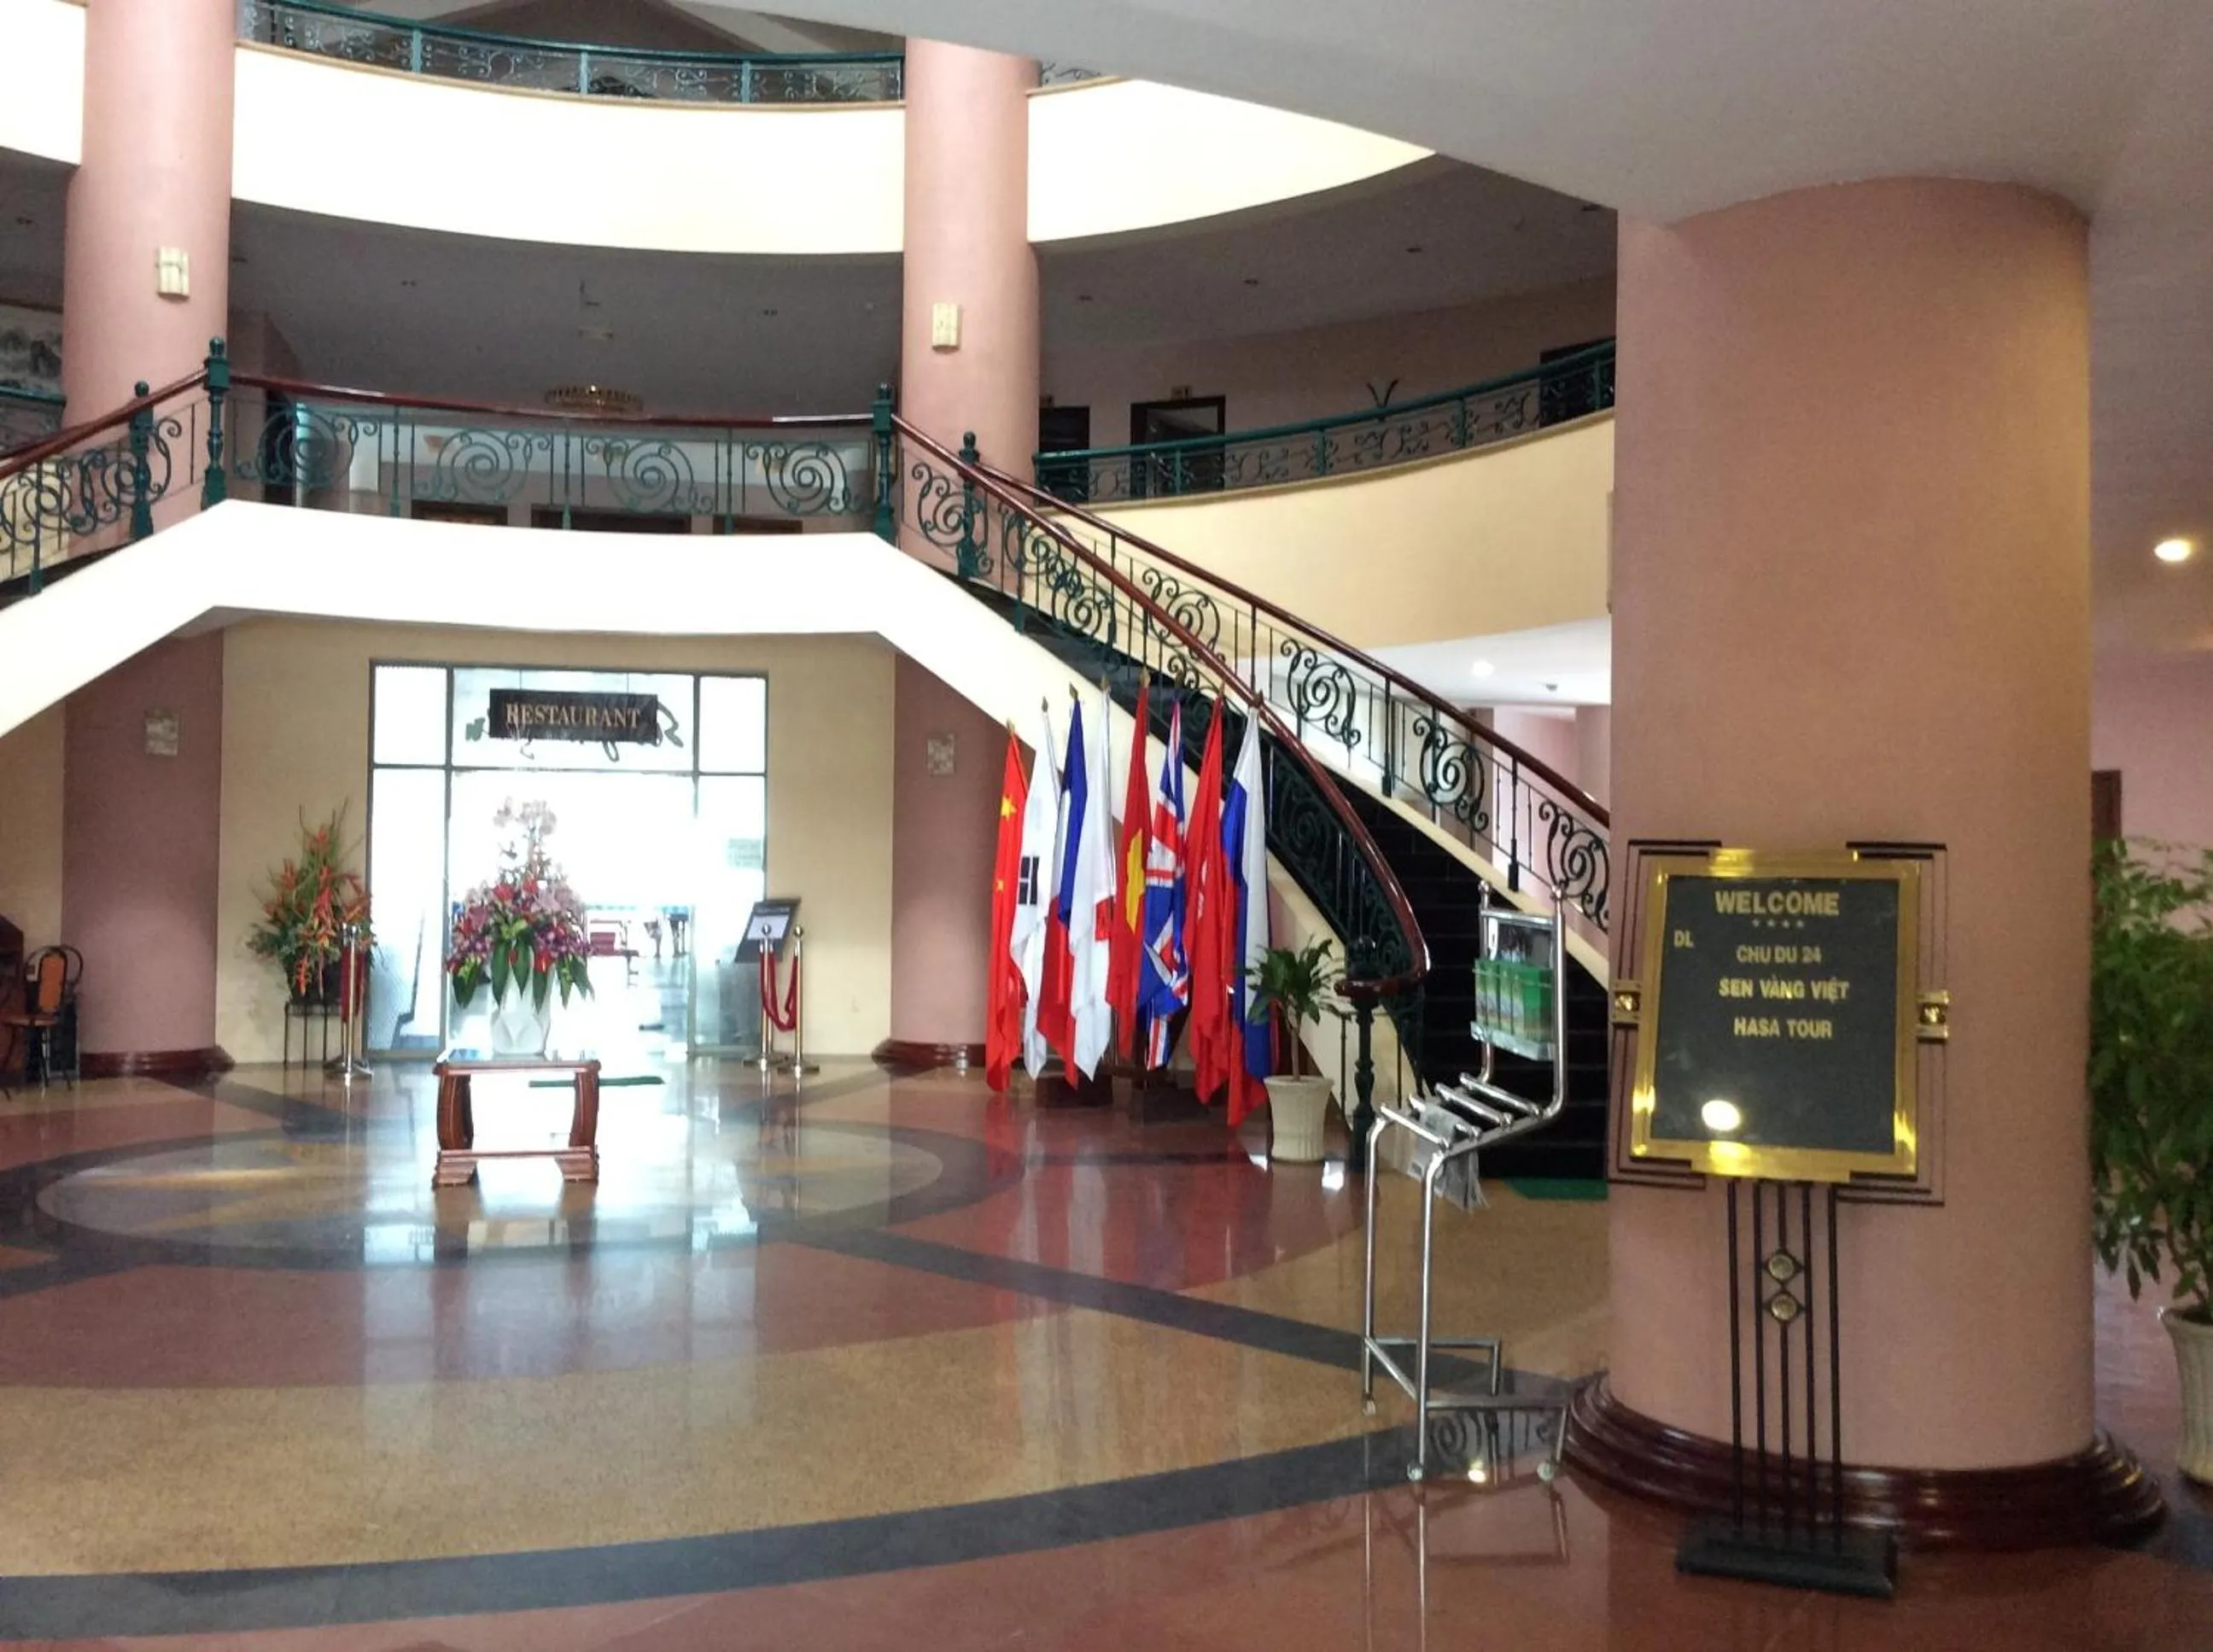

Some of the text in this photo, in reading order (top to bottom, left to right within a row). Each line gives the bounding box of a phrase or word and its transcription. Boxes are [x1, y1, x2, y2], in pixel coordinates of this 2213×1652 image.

[505, 703, 640, 729] RESTAURANT
[1714, 890, 1840, 916] WELCOME
[1673, 930, 1695, 949] DL
[1736, 944, 1822, 964] CHU DU 24
[1718, 973, 1850, 1004] SEN VÀNG VIỆT
[1786, 1019, 1832, 1039] TOUR
